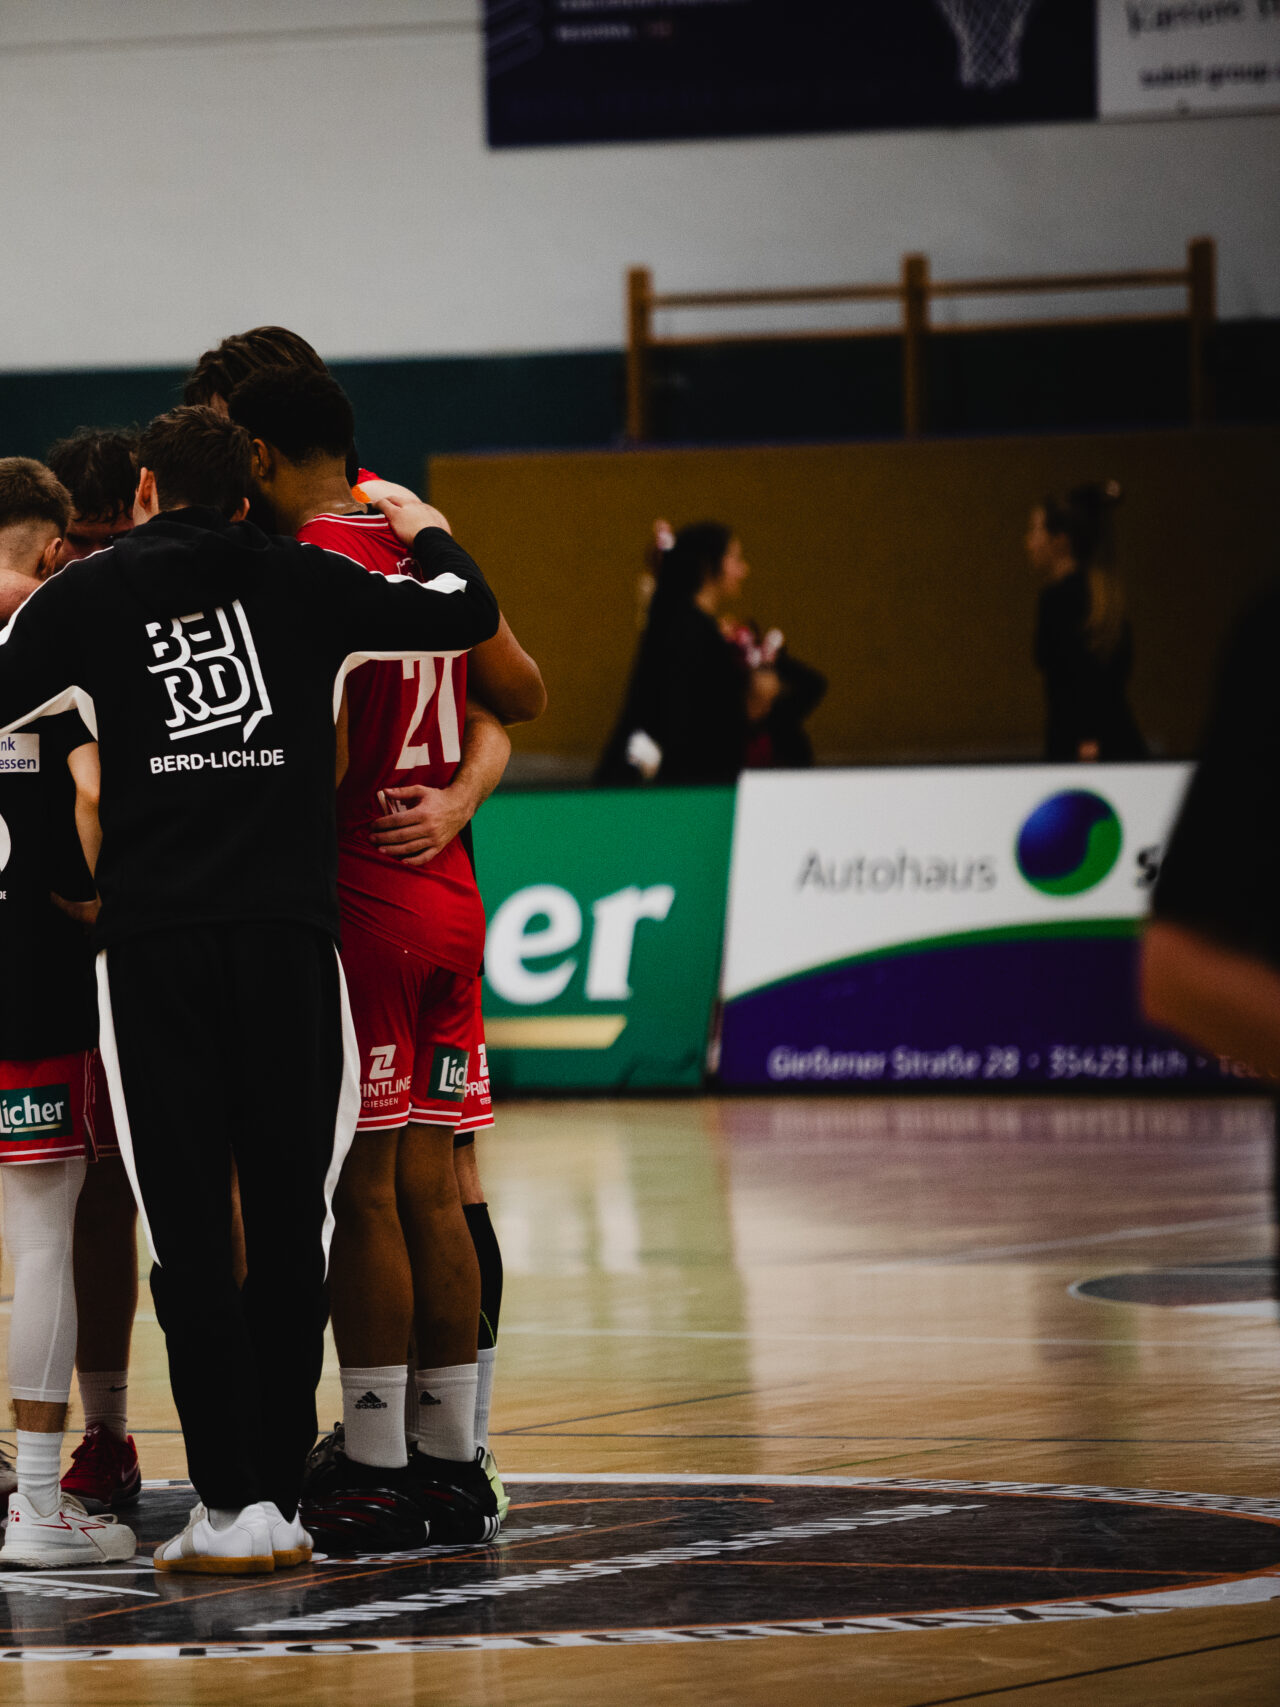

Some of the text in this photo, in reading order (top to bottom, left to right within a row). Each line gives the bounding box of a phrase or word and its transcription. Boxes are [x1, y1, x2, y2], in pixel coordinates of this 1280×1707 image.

[395, 656, 461, 770] 21
[150, 749, 285, 774] BERD-LICH.DE
[799, 850, 998, 894] Autohaus
[485, 884, 675, 1005] er
[984, 1045, 1020, 1079] 28
[1049, 1045, 1128, 1079] 35423
[176, 1600, 1183, 1657] POSTERMAXX
